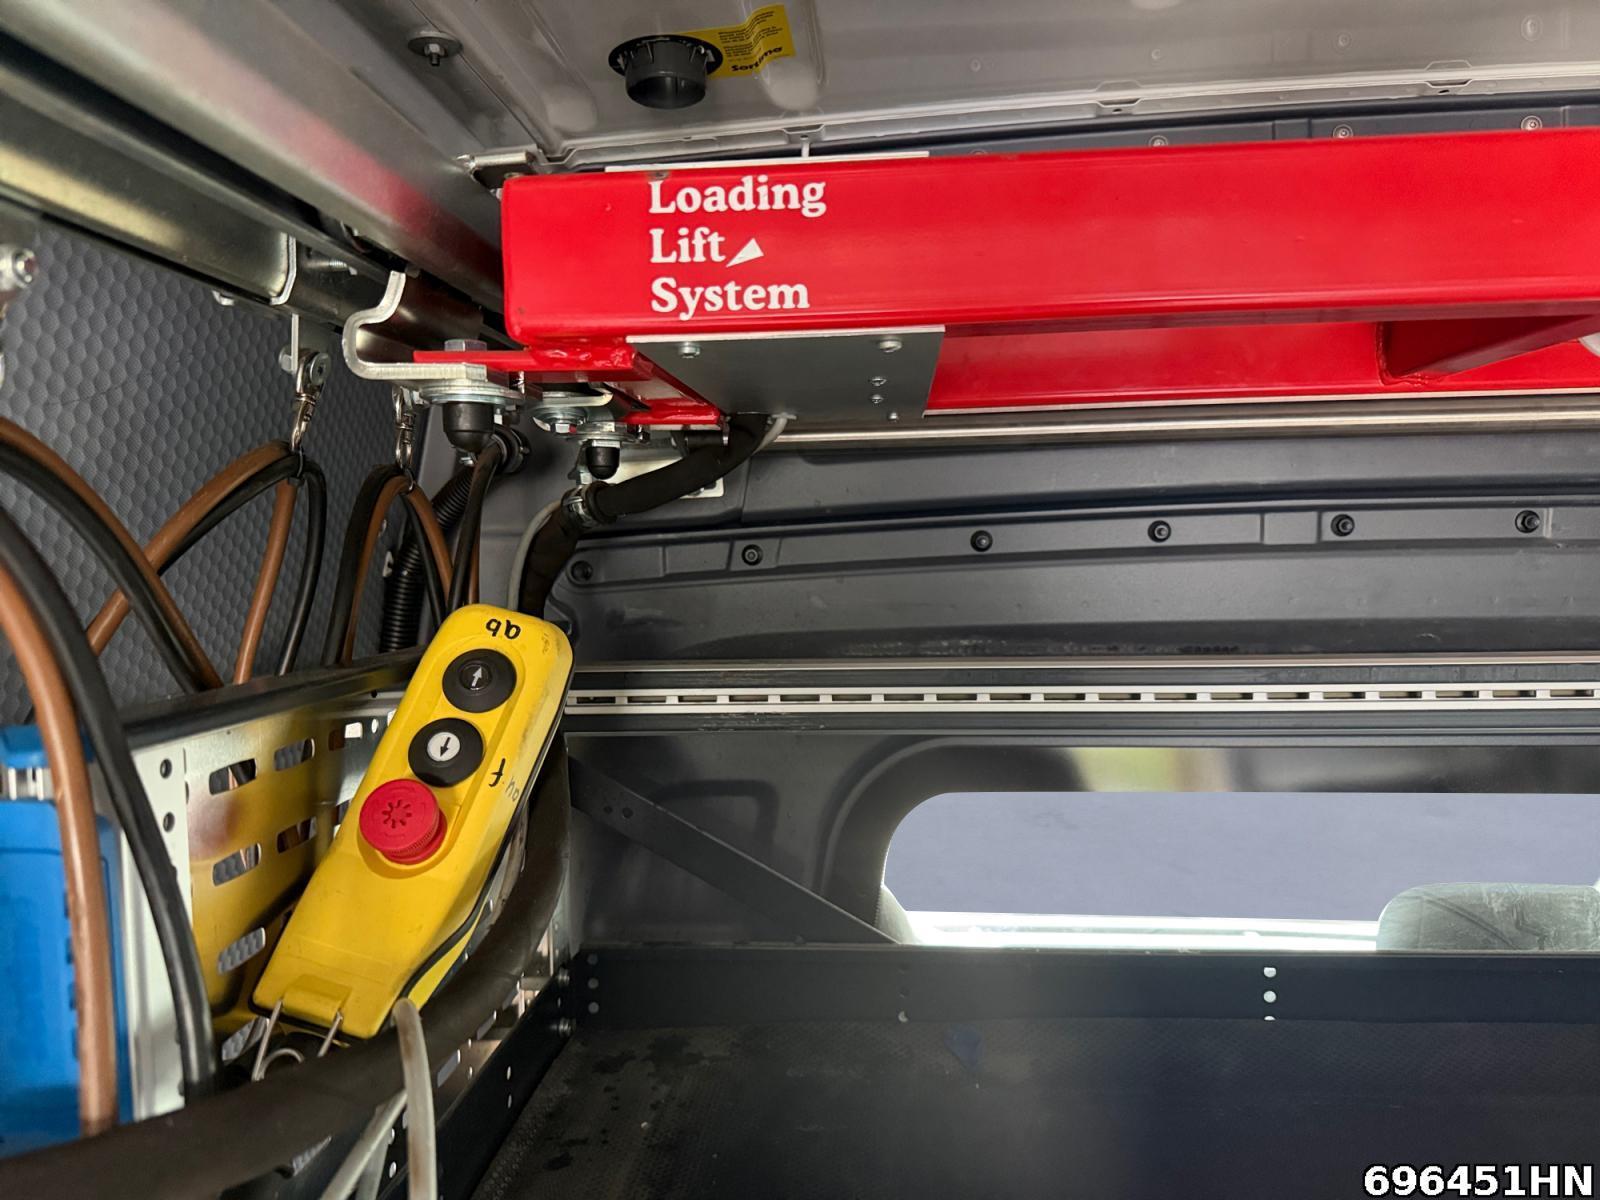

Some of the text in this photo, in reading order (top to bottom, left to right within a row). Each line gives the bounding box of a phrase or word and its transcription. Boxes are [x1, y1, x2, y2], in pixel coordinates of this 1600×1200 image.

[648, 174, 827, 218] Loading
[649, 226, 726, 263] Lift
[651, 276, 811, 321] System
